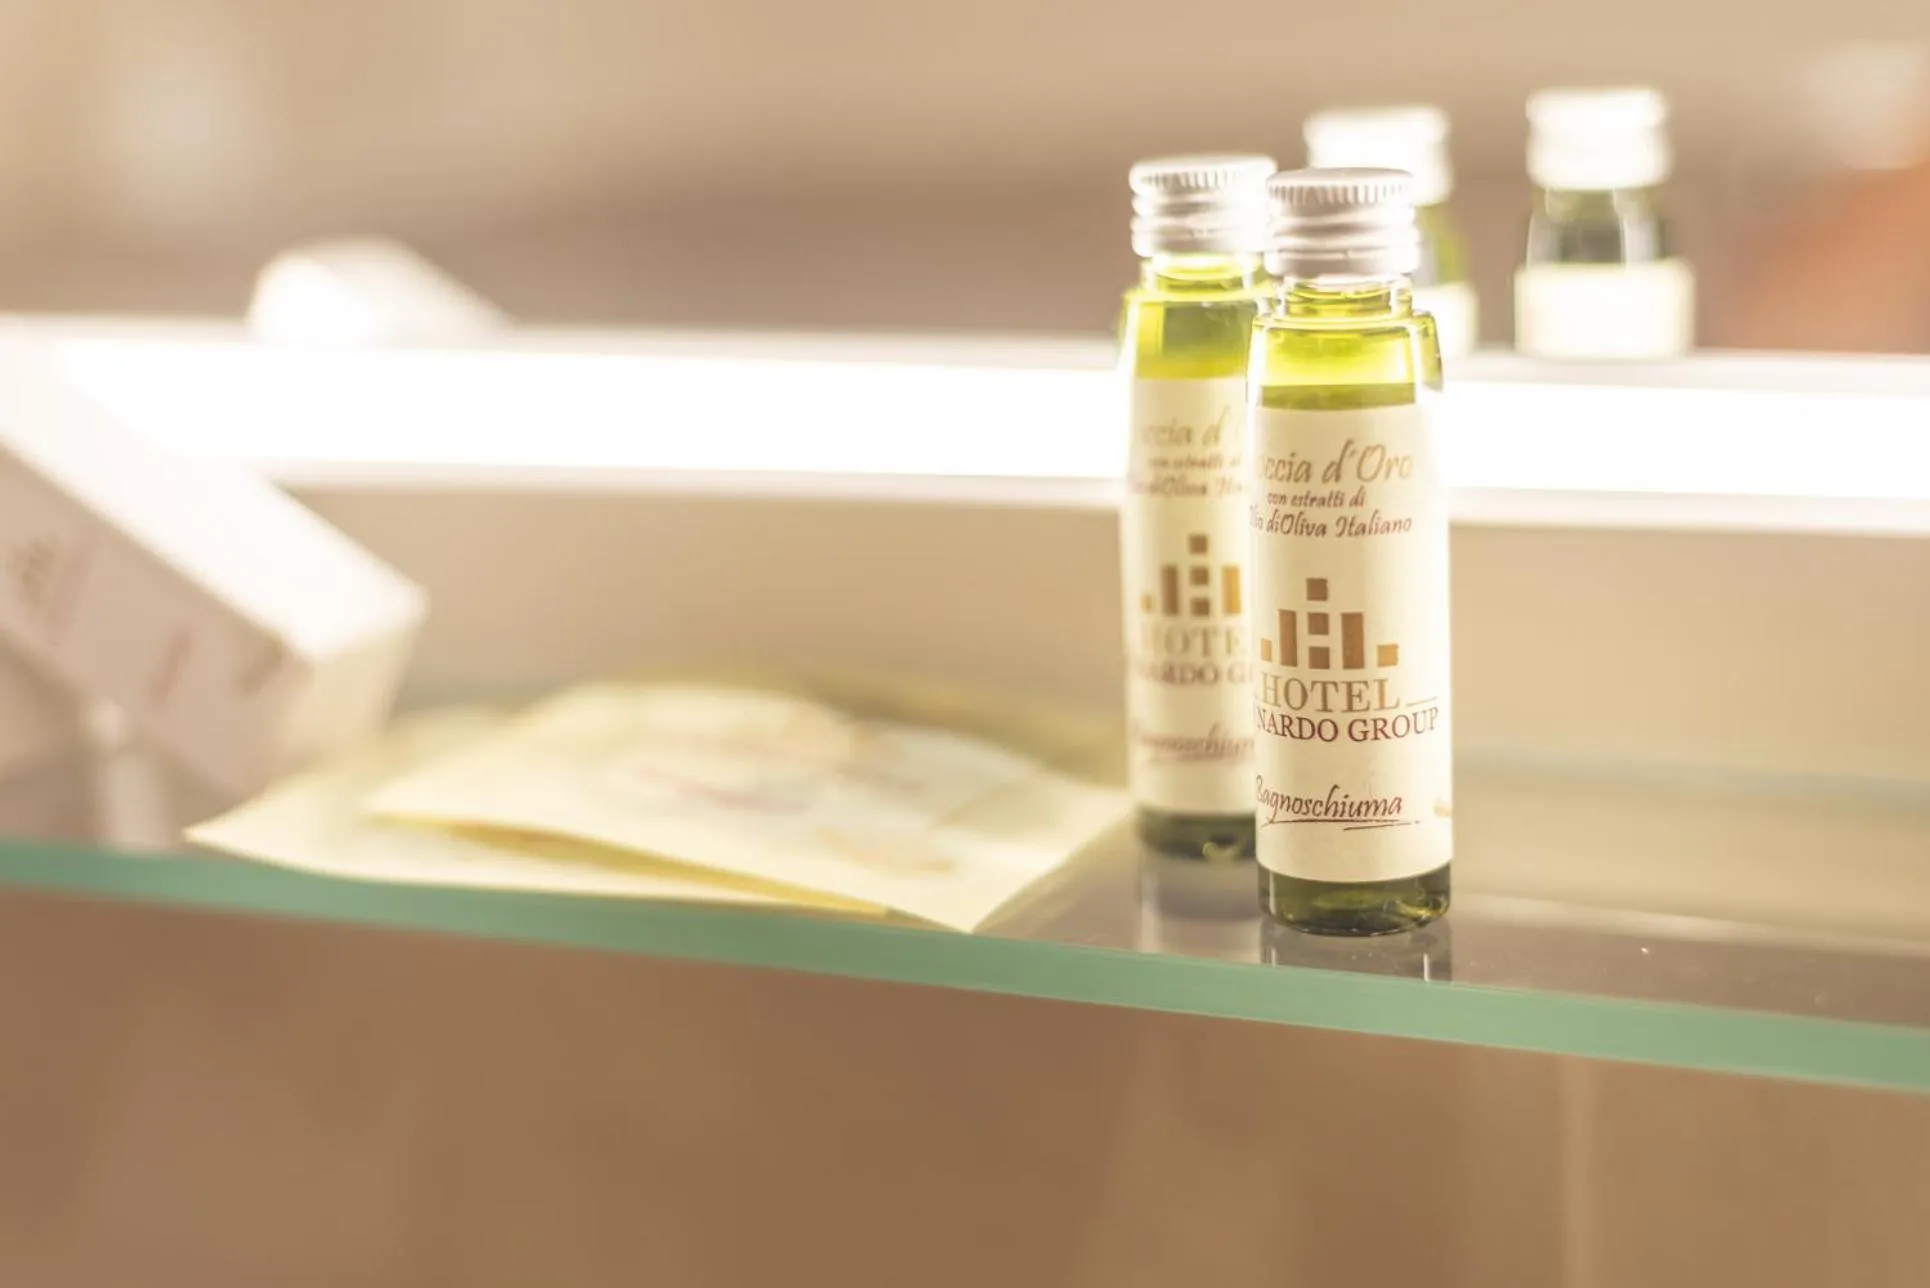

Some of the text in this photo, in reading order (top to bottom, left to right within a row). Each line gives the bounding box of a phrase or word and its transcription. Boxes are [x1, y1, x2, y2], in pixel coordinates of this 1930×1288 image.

[1321, 438, 1413, 484] d'Oro
[1267, 485, 1366, 509] con estratti di
[1335, 508, 1413, 538] Italiano
[1261, 672, 1401, 713] HOTEL
[1348, 705, 1439, 743] GROUP
